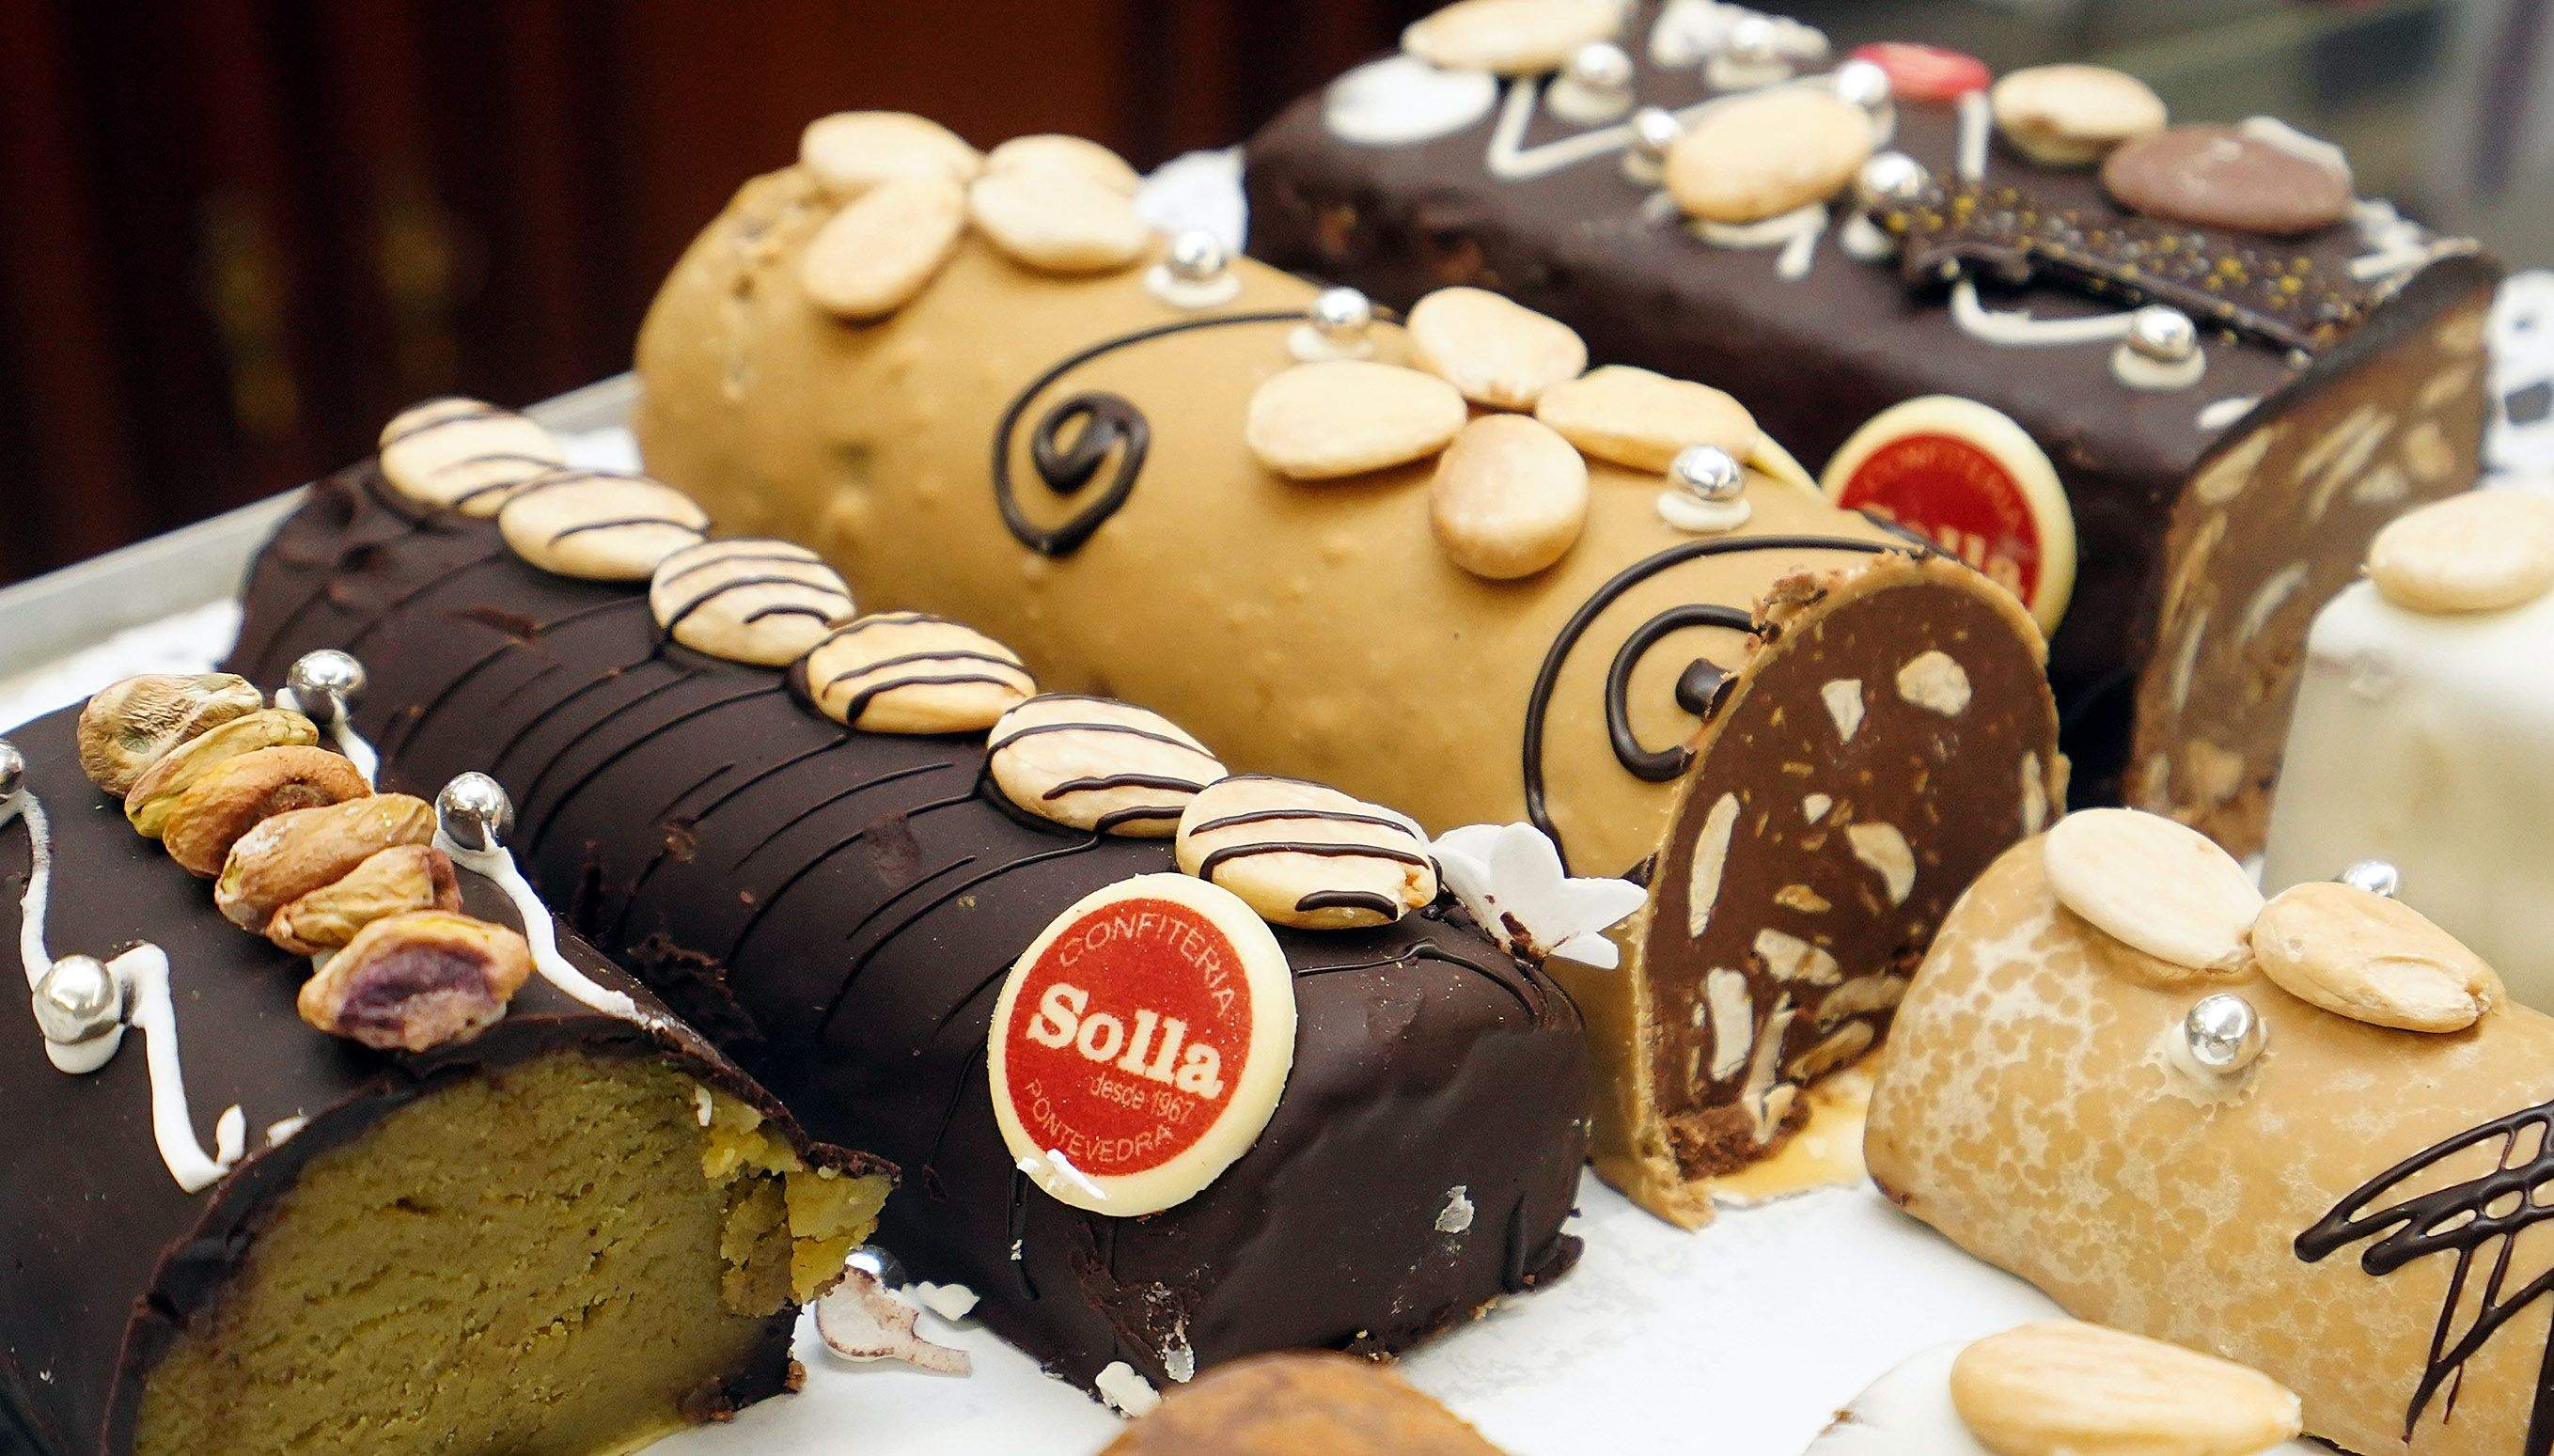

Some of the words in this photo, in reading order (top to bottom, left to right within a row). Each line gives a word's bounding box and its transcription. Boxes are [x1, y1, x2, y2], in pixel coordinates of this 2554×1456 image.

[1026, 983, 1224, 1100] Solla
[1026, 1079, 1174, 1163] PONTEVEDRA
[1090, 1072, 1145, 1110] desde
[1152, 1089, 1196, 1124] 1967
